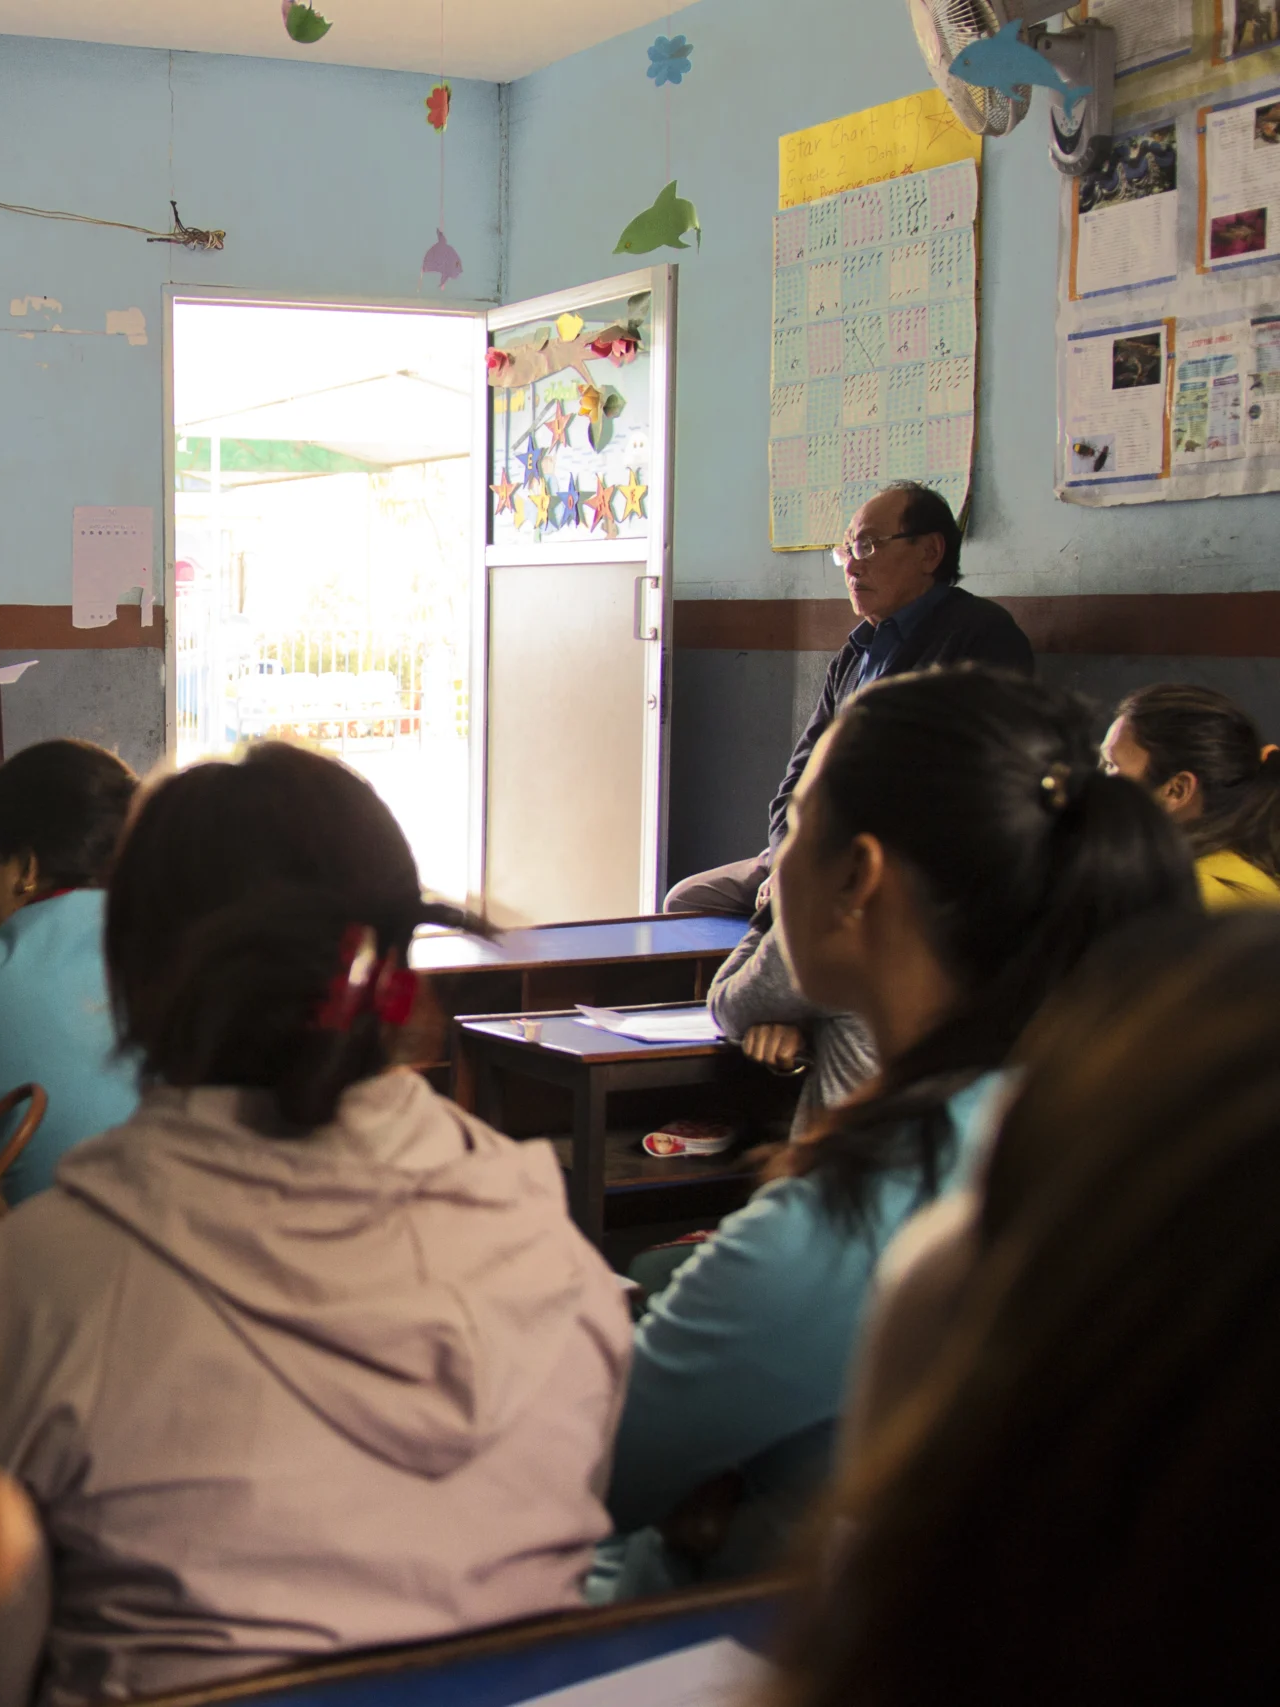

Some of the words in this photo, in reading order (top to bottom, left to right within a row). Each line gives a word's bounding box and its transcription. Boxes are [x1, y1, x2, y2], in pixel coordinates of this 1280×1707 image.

[786, 138, 821, 163] Star
[830, 113, 878, 149] Chart
[892, 96, 915, 130] of
[786, 167, 830, 189] Grade
[836, 154, 847, 177] 2
